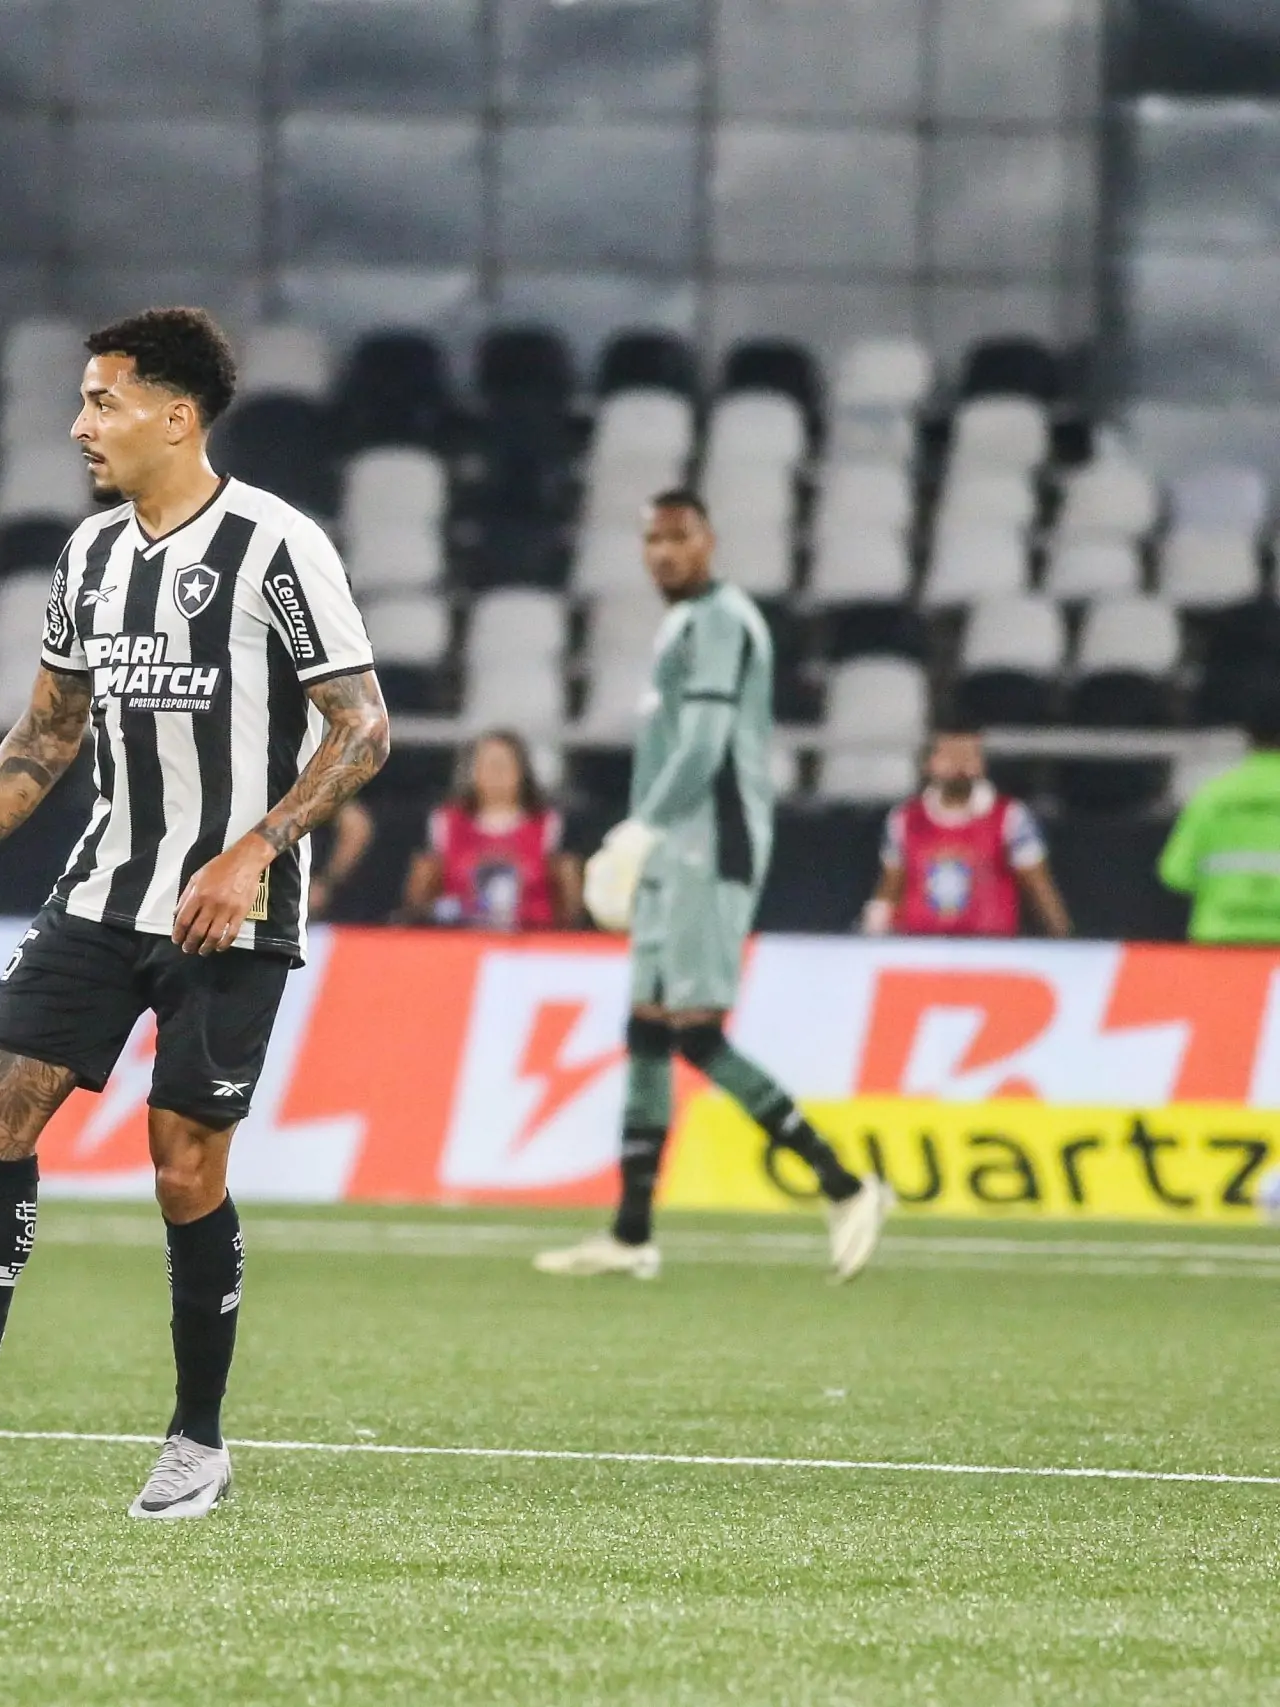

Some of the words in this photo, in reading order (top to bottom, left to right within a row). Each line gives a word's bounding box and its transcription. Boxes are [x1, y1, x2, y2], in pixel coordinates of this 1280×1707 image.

[271, 573, 316, 659] Centrum
[83, 635, 165, 668] PARI
[94, 665, 220, 697] MATCH
[128, 697, 160, 709] APOSTAS
[160, 698, 211, 711] ESPORTIVAS
